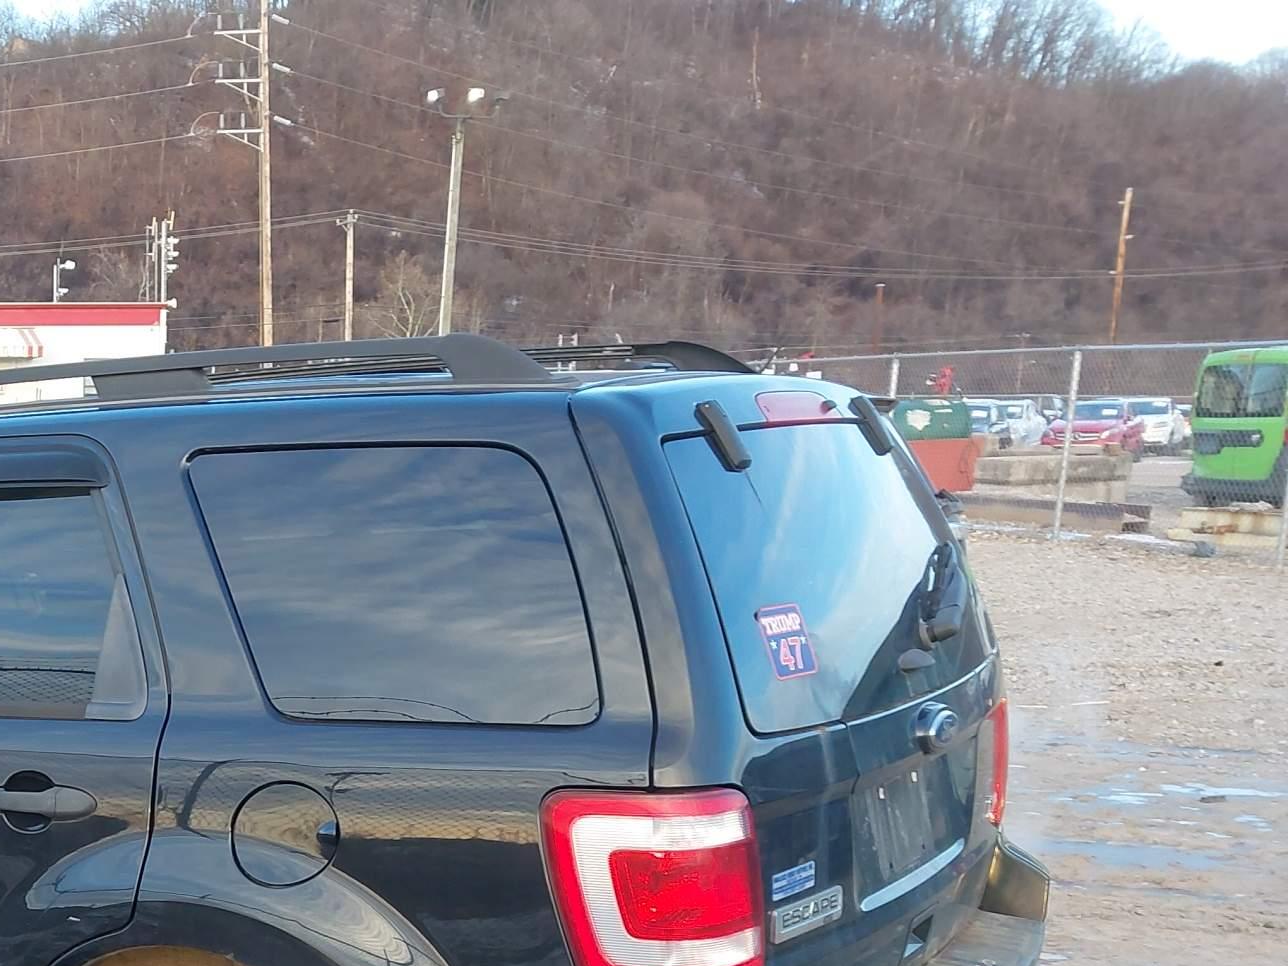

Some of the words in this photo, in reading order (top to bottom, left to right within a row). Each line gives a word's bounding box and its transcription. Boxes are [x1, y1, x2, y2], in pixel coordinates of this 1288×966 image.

[760, 612, 801, 636] TRUMP
[779, 636, 804, 671] 47
[782, 892, 838, 929] ESCAPE
